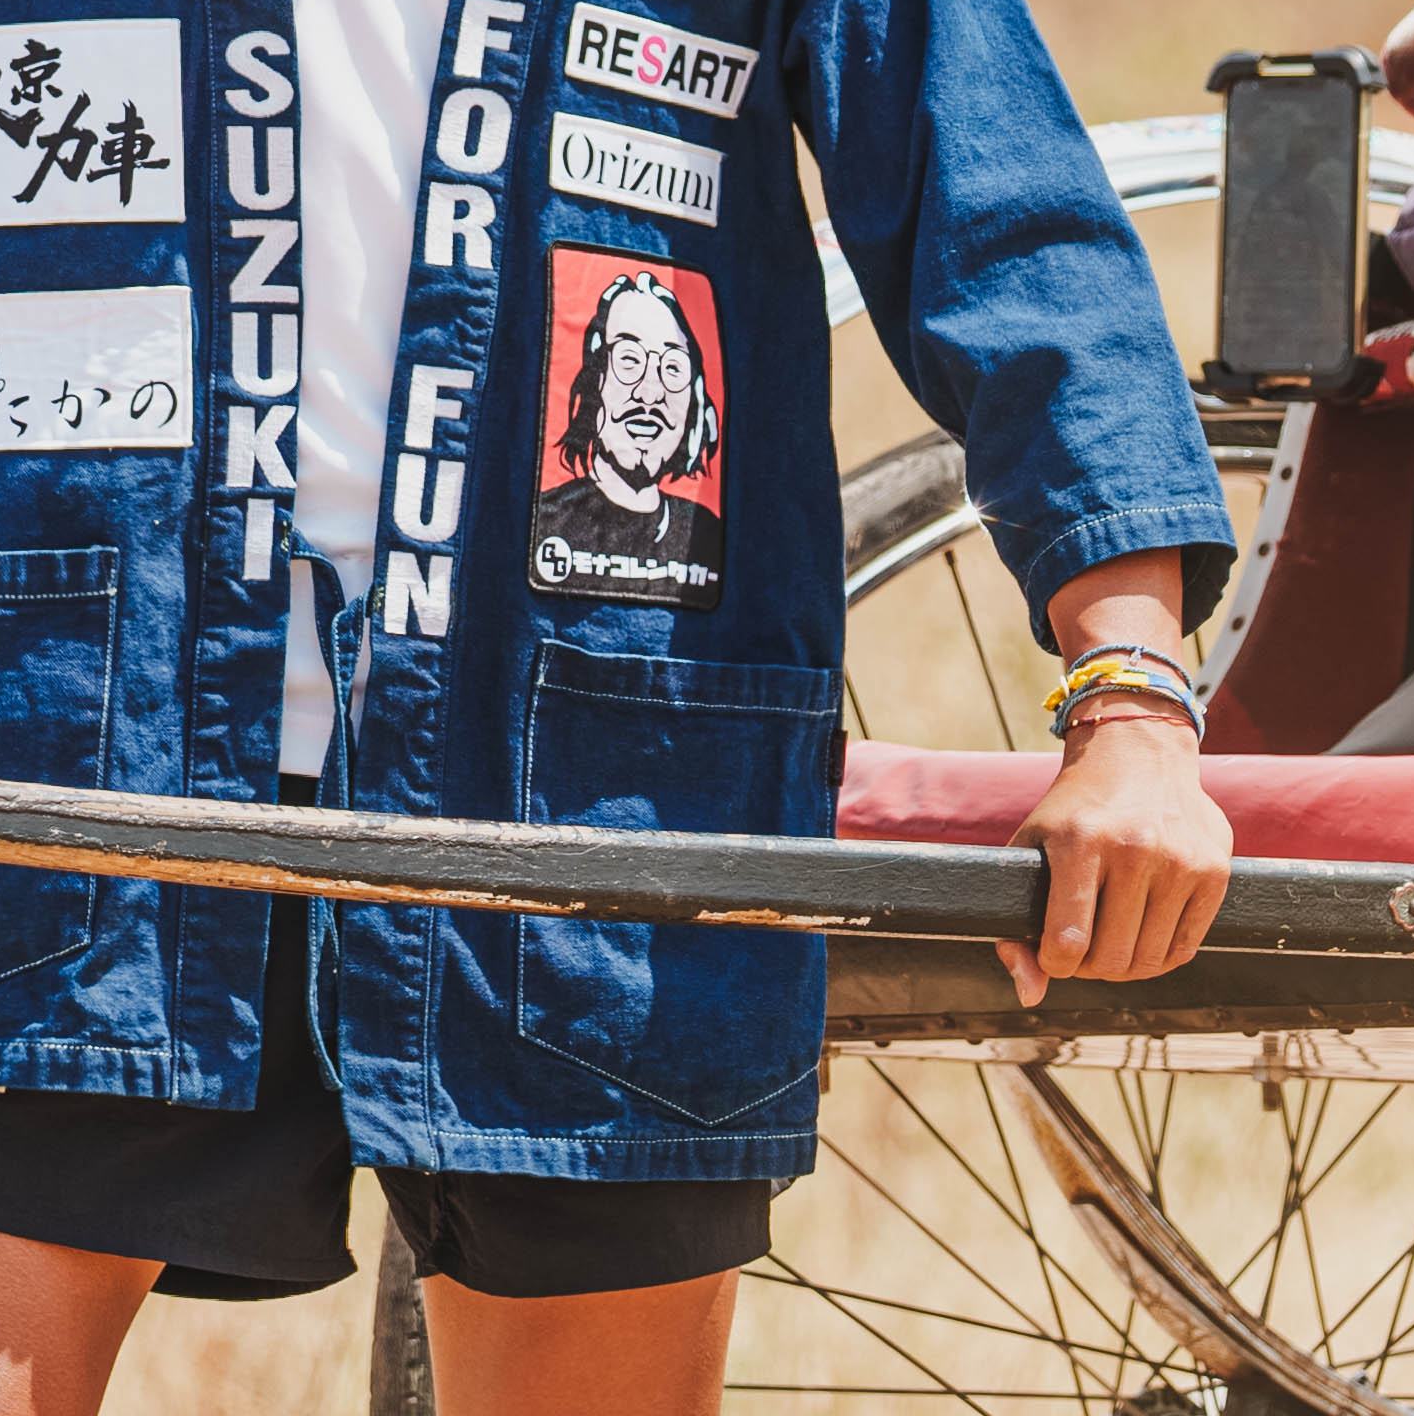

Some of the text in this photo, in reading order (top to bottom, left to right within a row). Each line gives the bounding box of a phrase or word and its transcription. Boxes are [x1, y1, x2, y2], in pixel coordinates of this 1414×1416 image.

[577, 20, 748, 104] RESART
[563, 133, 713, 211] Orizum
[225, 30, 300, 581] SUZUKI
[384, 364, 474, 637] FUN
[573, 549, 719, 587] モナコレンタカー
